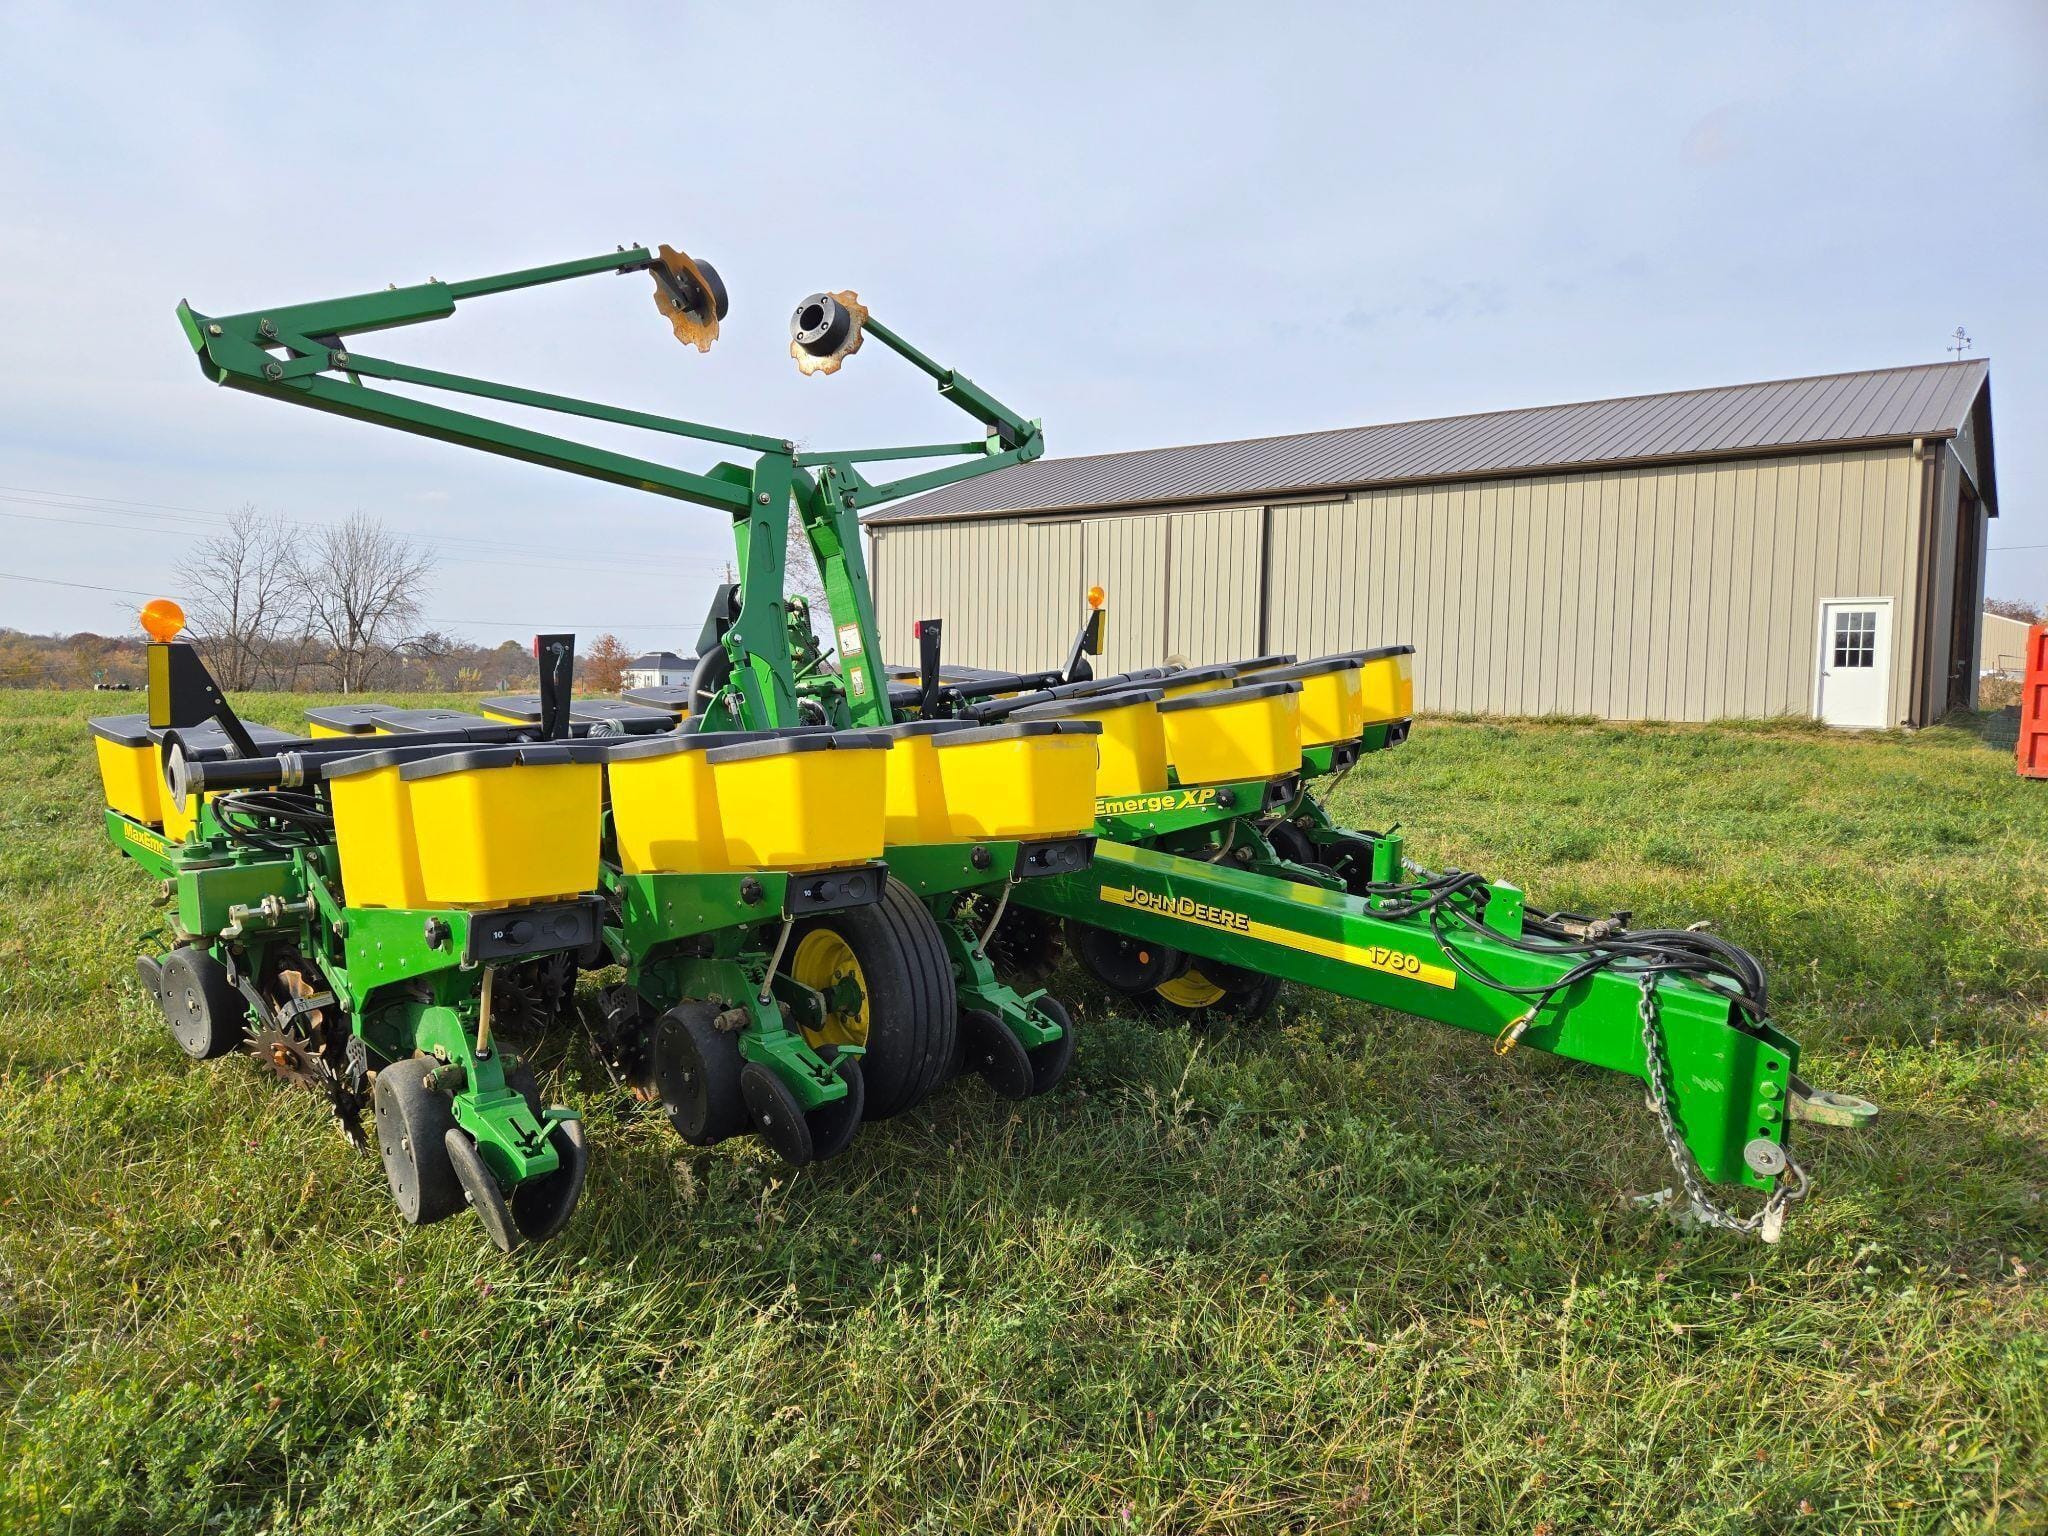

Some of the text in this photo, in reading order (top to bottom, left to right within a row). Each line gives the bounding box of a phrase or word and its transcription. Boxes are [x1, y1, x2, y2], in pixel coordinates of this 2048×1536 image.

[1175, 788, 1216, 809] XP
[493, 931, 504, 939] 10
[1368, 945, 1420, 973] 1760
